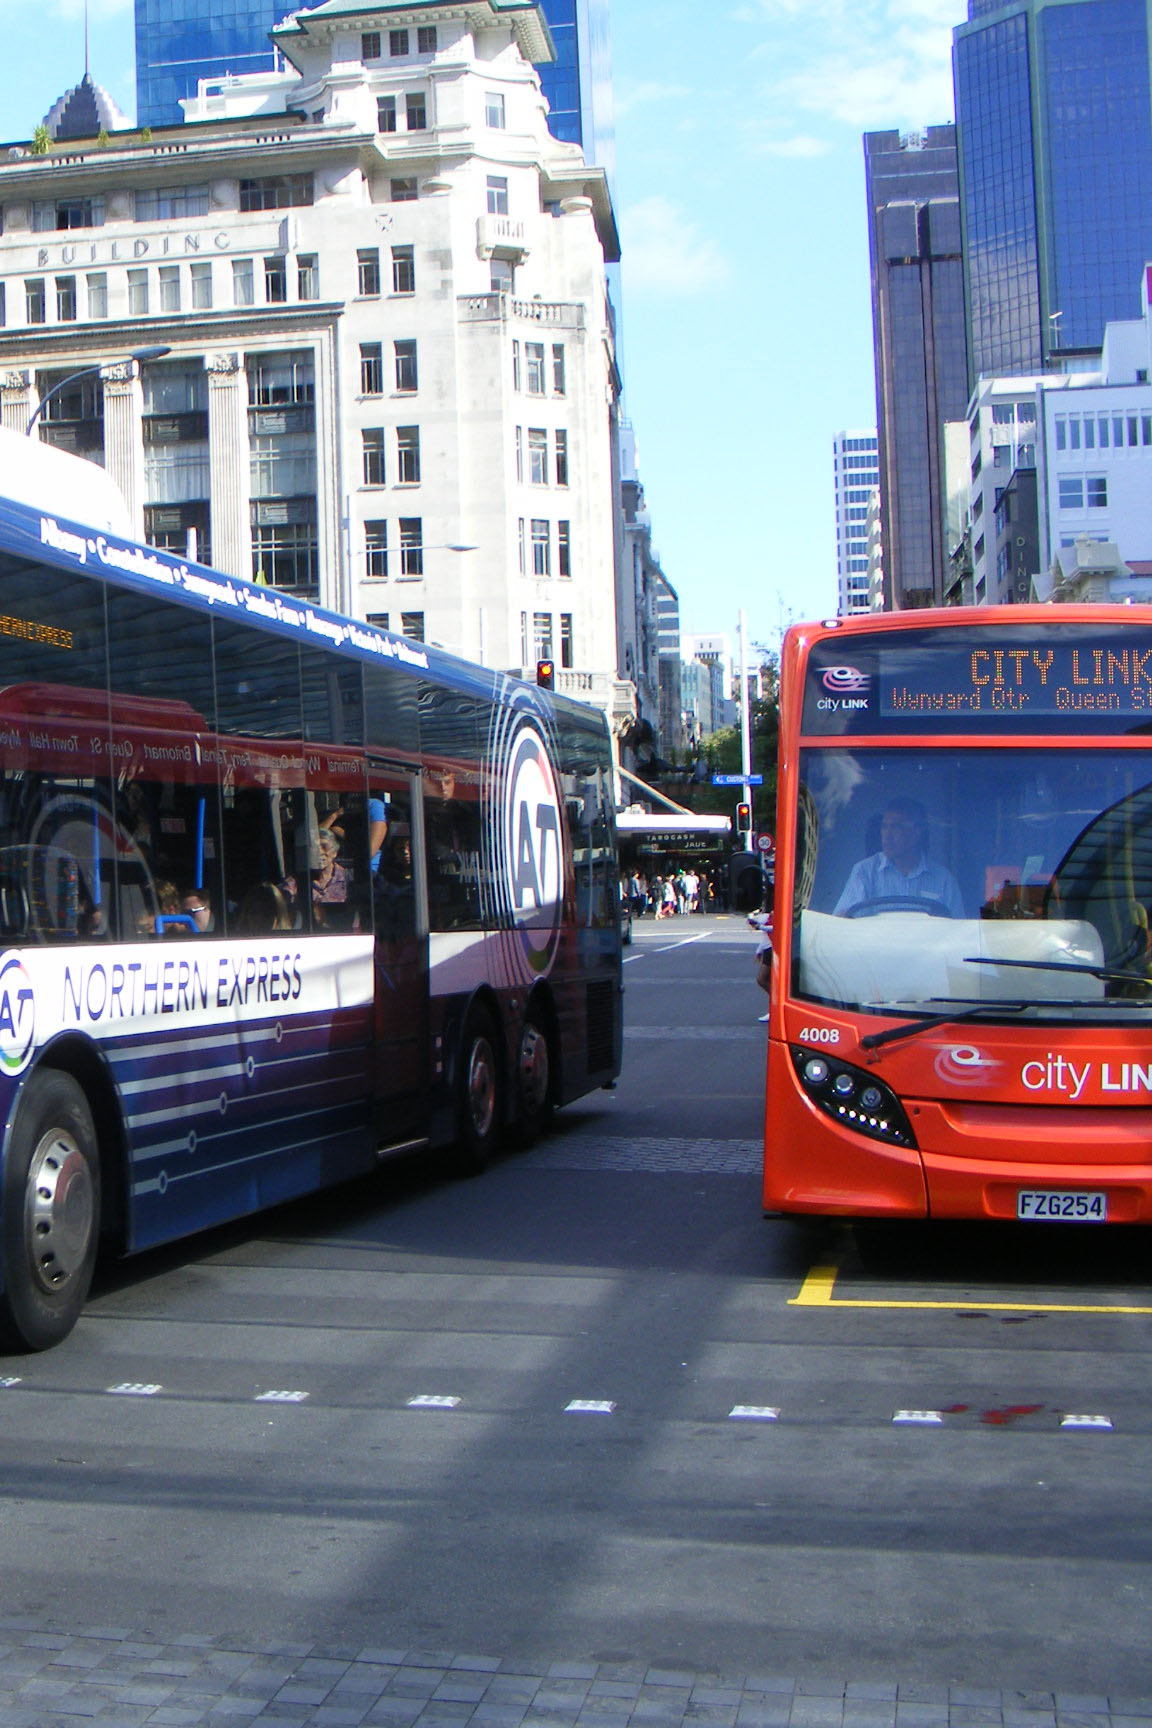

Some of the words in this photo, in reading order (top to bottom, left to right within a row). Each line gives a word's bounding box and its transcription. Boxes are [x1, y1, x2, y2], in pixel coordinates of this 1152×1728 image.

[971, 650, 1054, 685] CITY
[1072, 650, 1152, 685] LINK
[817, 697, 840, 712] city
[841, 699, 869, 709] LINK
[892, 687, 981, 710] Wynyard
[991, 687, 1030, 710] Qtr
[1056, 687, 1120, 710] Queen
[514, 800, 556, 909] AT
[62, 960, 209, 1022] NORTHERN
[216, 953, 302, 1008] EXPRESS
[799, 1027, 840, 1043] 4008
[1021, 1053, 1091, 1099] city
[1101, 1063, 1152, 1091] LIN
[1021, 1194, 1102, 1217] FZG254
